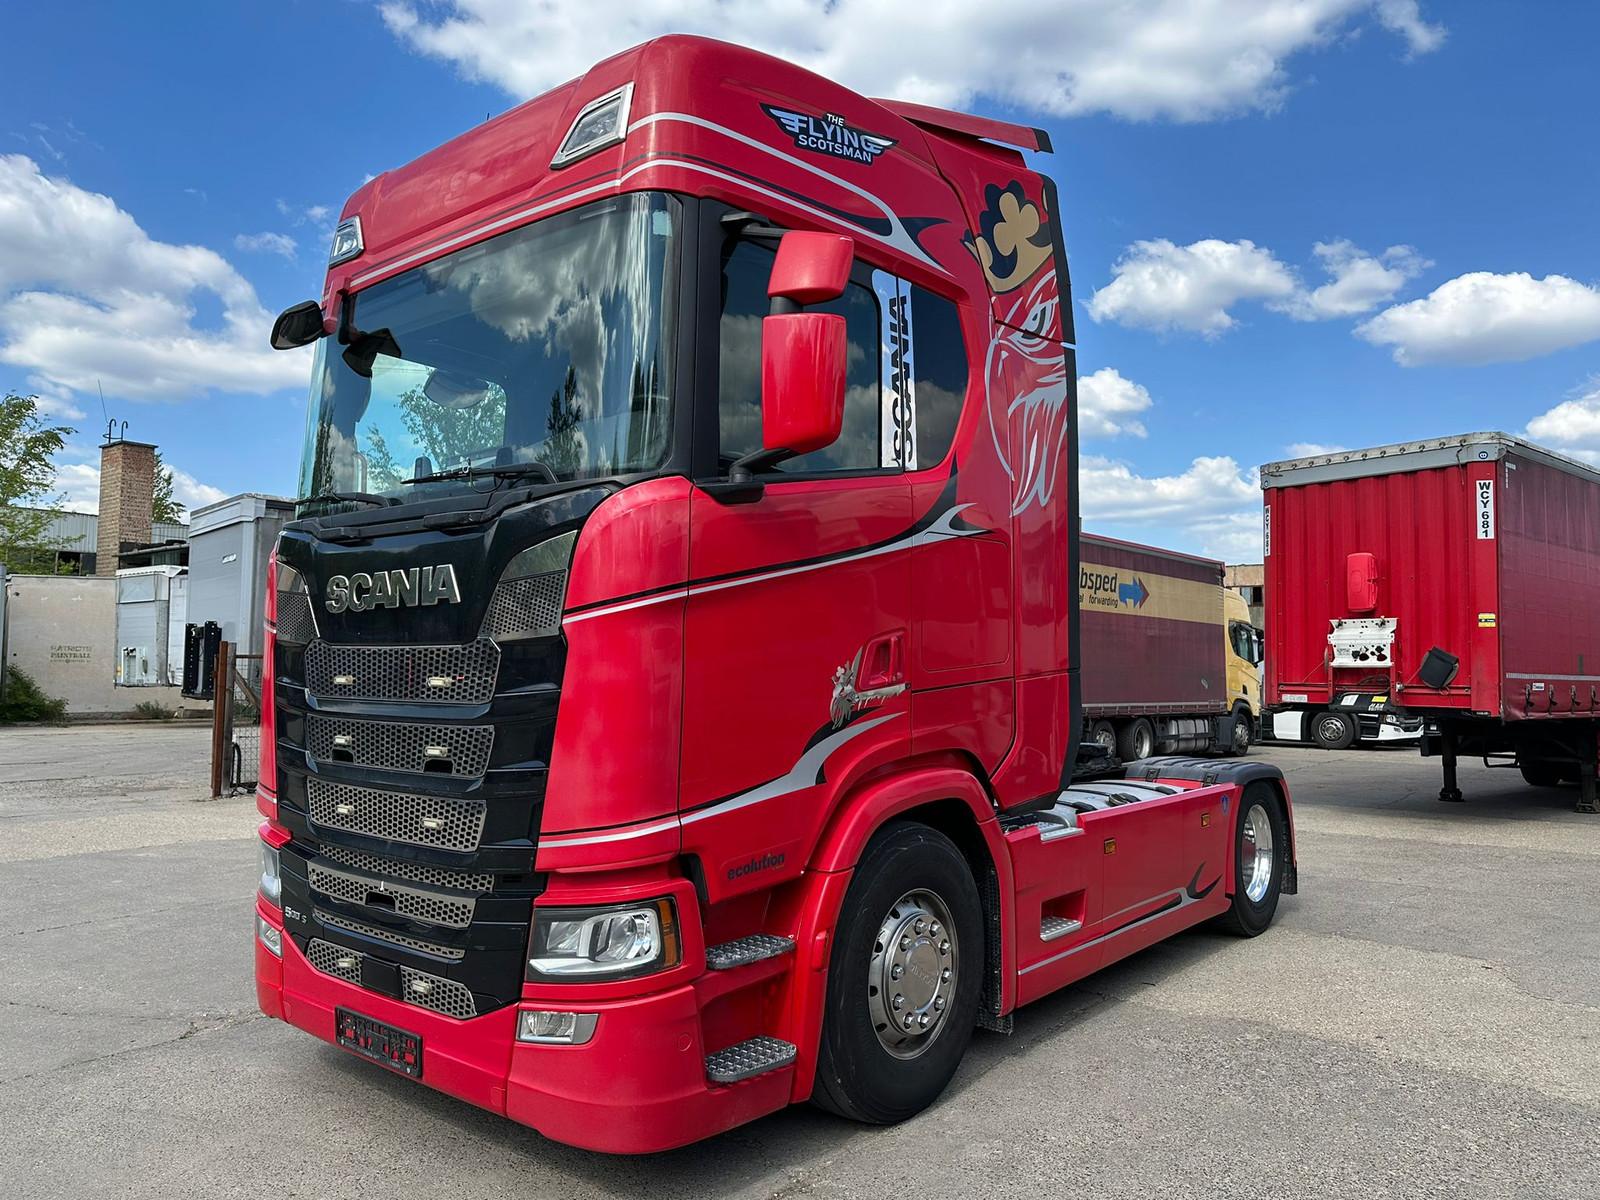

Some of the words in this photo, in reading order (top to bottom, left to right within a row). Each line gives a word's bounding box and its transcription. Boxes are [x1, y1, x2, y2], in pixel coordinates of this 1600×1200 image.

[769, 108, 893, 154] FLYING
[827, 113, 844, 126] THE
[798, 134, 872, 162] SCOTSMAN
[888, 296, 913, 463] SCANIA
[1478, 481, 1491, 508] WCY
[1481, 511, 1490, 537] 681
[325, 563, 461, 614] SCANIA
[1080, 567, 1118, 595] bsped
[1088, 594, 1119, 608] forwarding
[727, 853, 785, 880] ecolution
